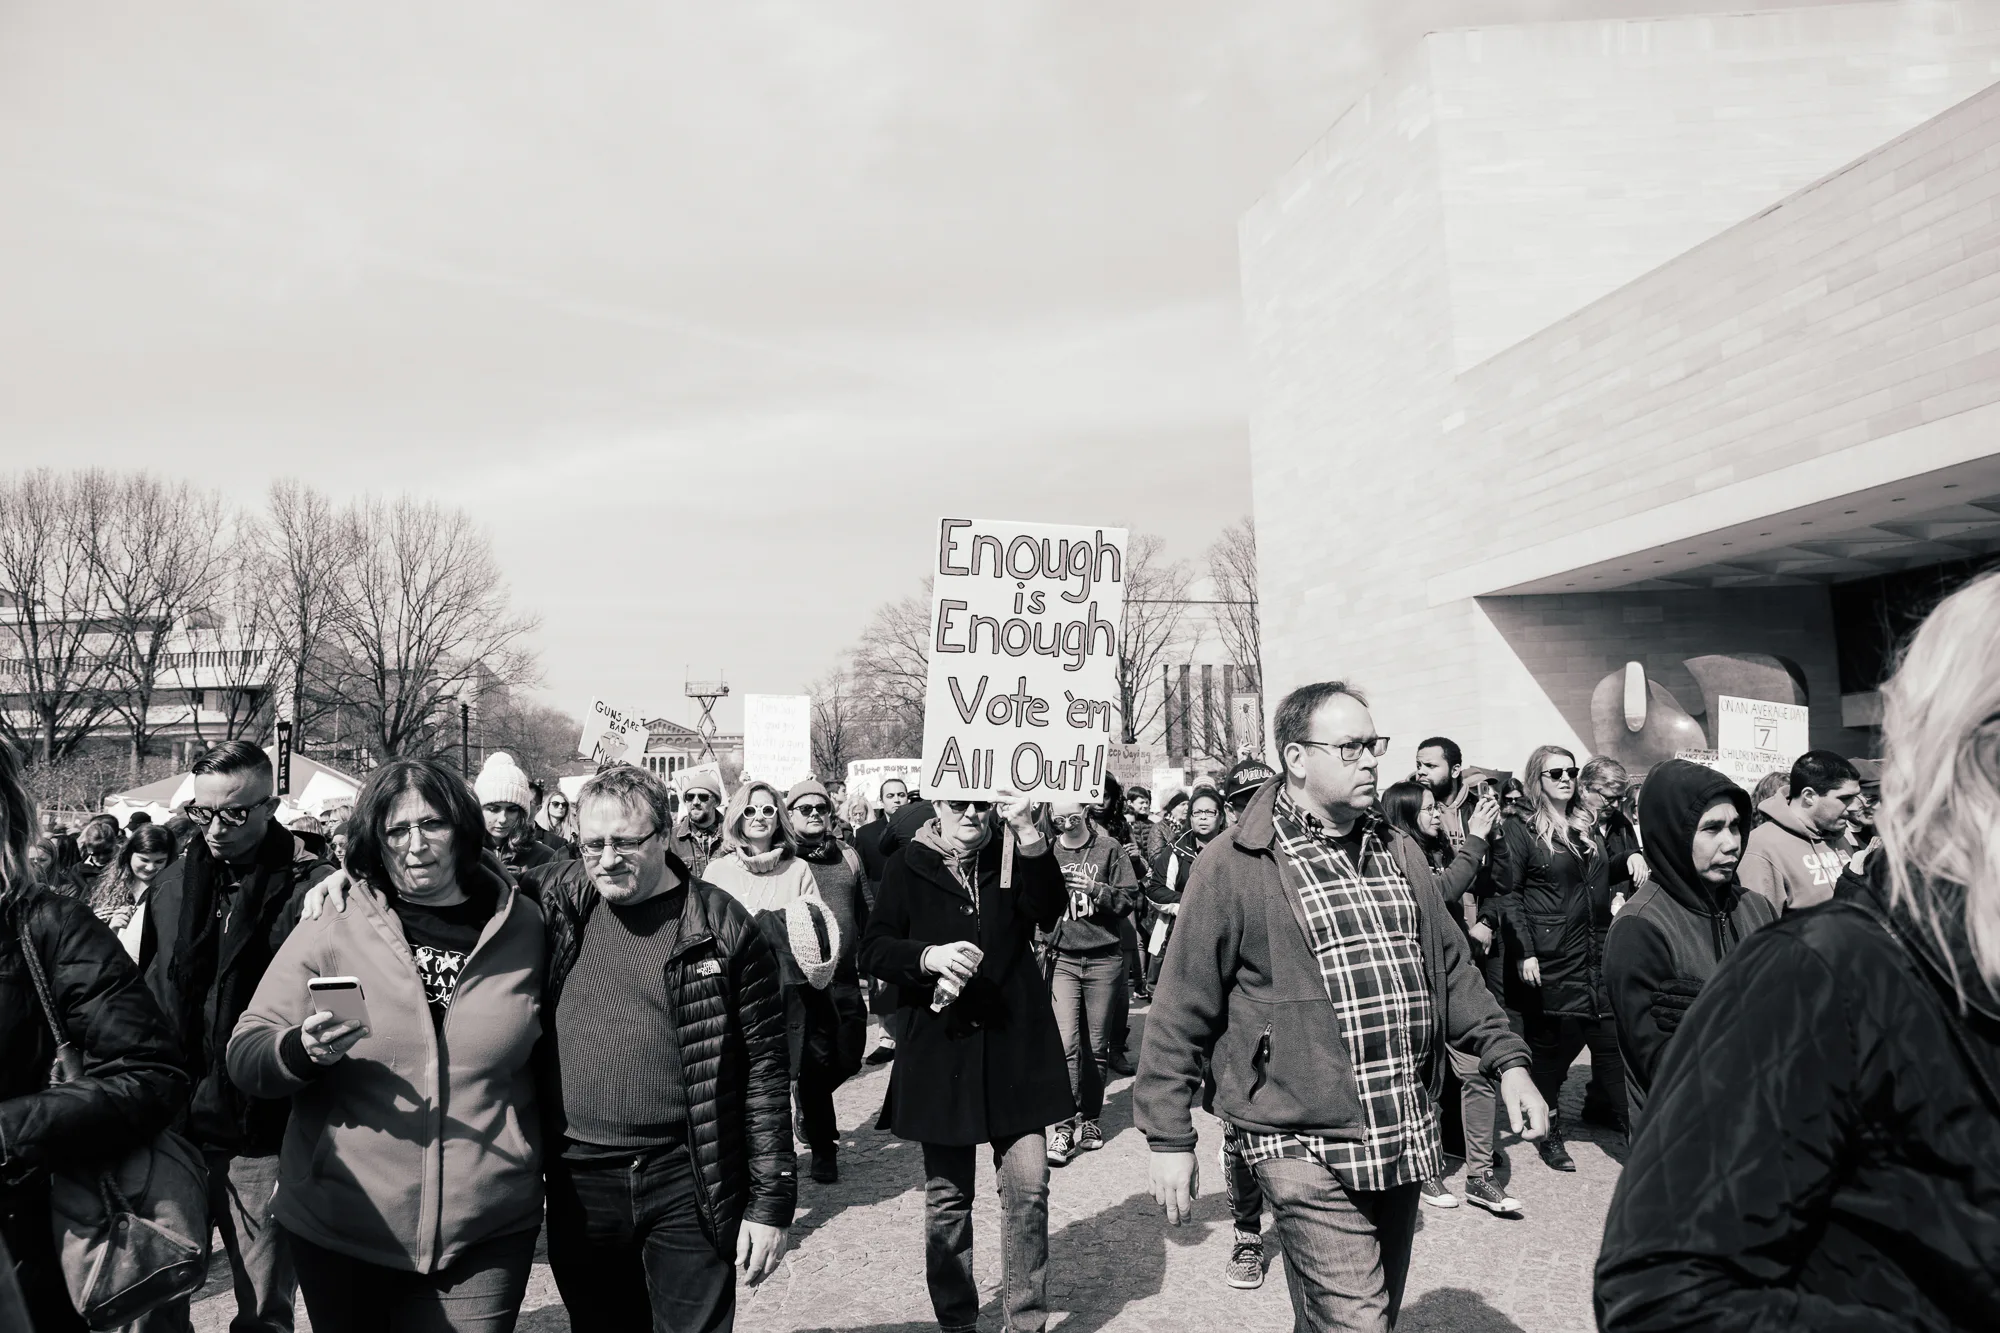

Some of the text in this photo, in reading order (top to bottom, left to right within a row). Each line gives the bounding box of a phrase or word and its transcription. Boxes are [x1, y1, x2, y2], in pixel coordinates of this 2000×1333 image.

[940, 519, 1121, 603] Enough
[1014, 582, 1045, 614] is
[936, 599, 1115, 671] Enough
[595, 700, 640, 732] GUNS ARE
[948, 676, 1049, 727] Vote
[1750, 703, 1788, 719] AVERAGE
[1790, 707, 1807, 722] DAY
[609, 720, 627, 734] BAD
[1759, 728, 1770, 747] 7
[279, 729, 290, 790] WATER
[931, 737, 1104, 798] All Out!
[1735, 761, 1744, 772] BY
[1747, 762, 1765, 773] GUNS
